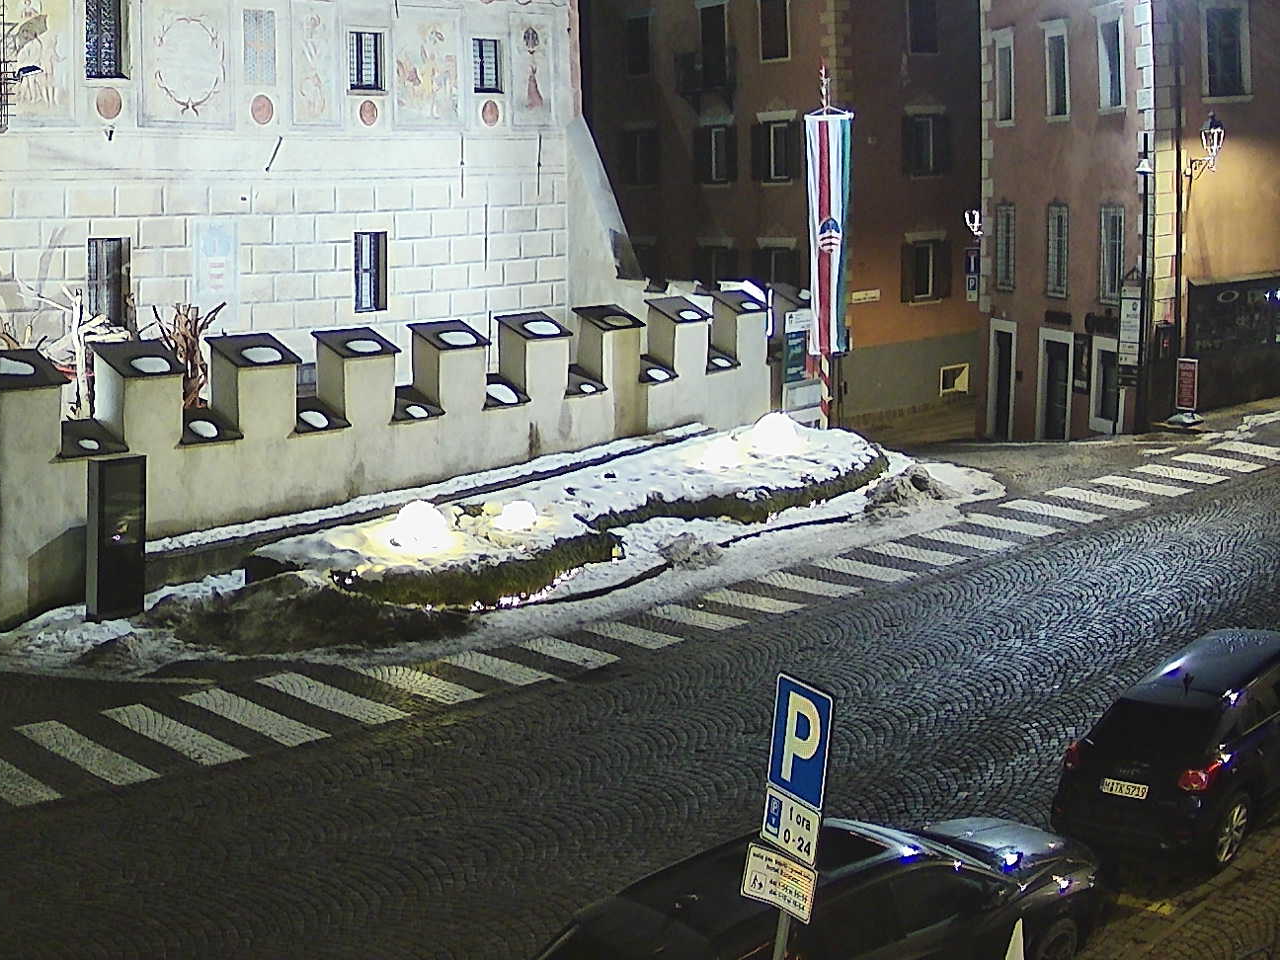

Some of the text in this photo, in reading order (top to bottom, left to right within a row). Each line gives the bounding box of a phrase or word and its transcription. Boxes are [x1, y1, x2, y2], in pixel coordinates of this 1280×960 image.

[780, 691, 821, 783] P
[789, 806, 812, 833] 1 ora
